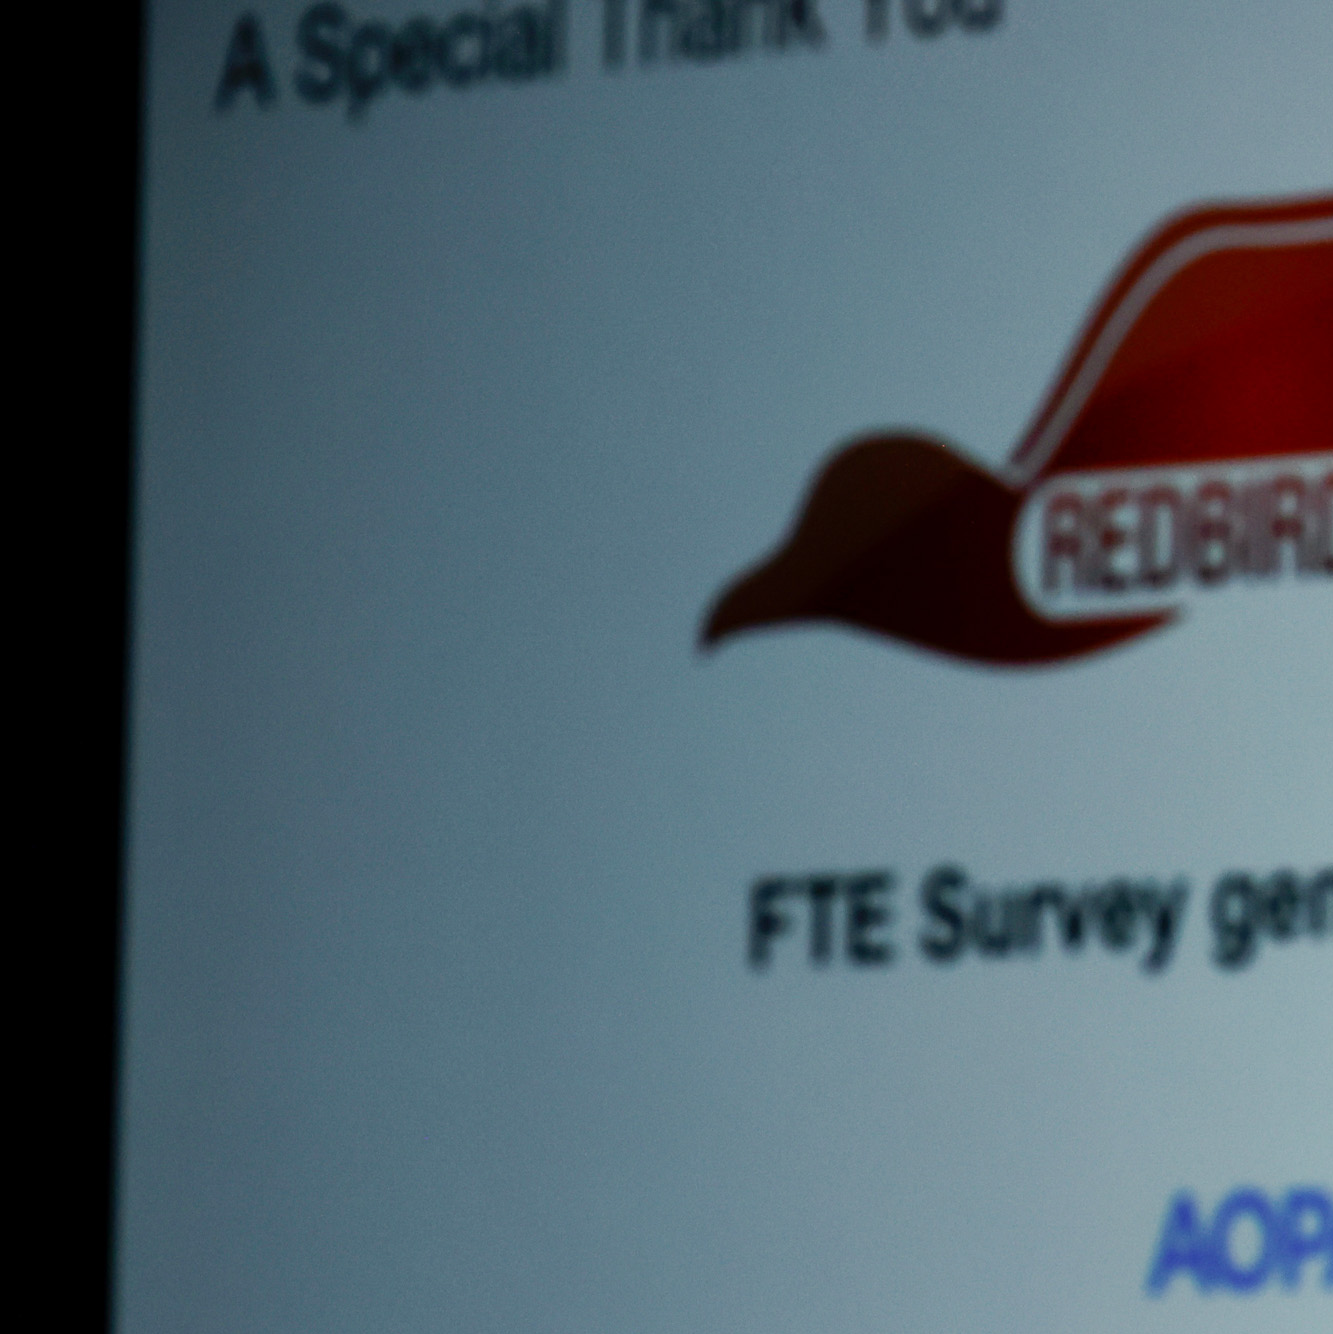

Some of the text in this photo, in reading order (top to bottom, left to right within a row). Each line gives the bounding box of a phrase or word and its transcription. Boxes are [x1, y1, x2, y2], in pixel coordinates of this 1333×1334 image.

[214, 12, 277, 112] A
[298, 1, 566, 122] Special
[747, 870, 896, 970] FTE
[918, 864, 1190, 976] Survey
